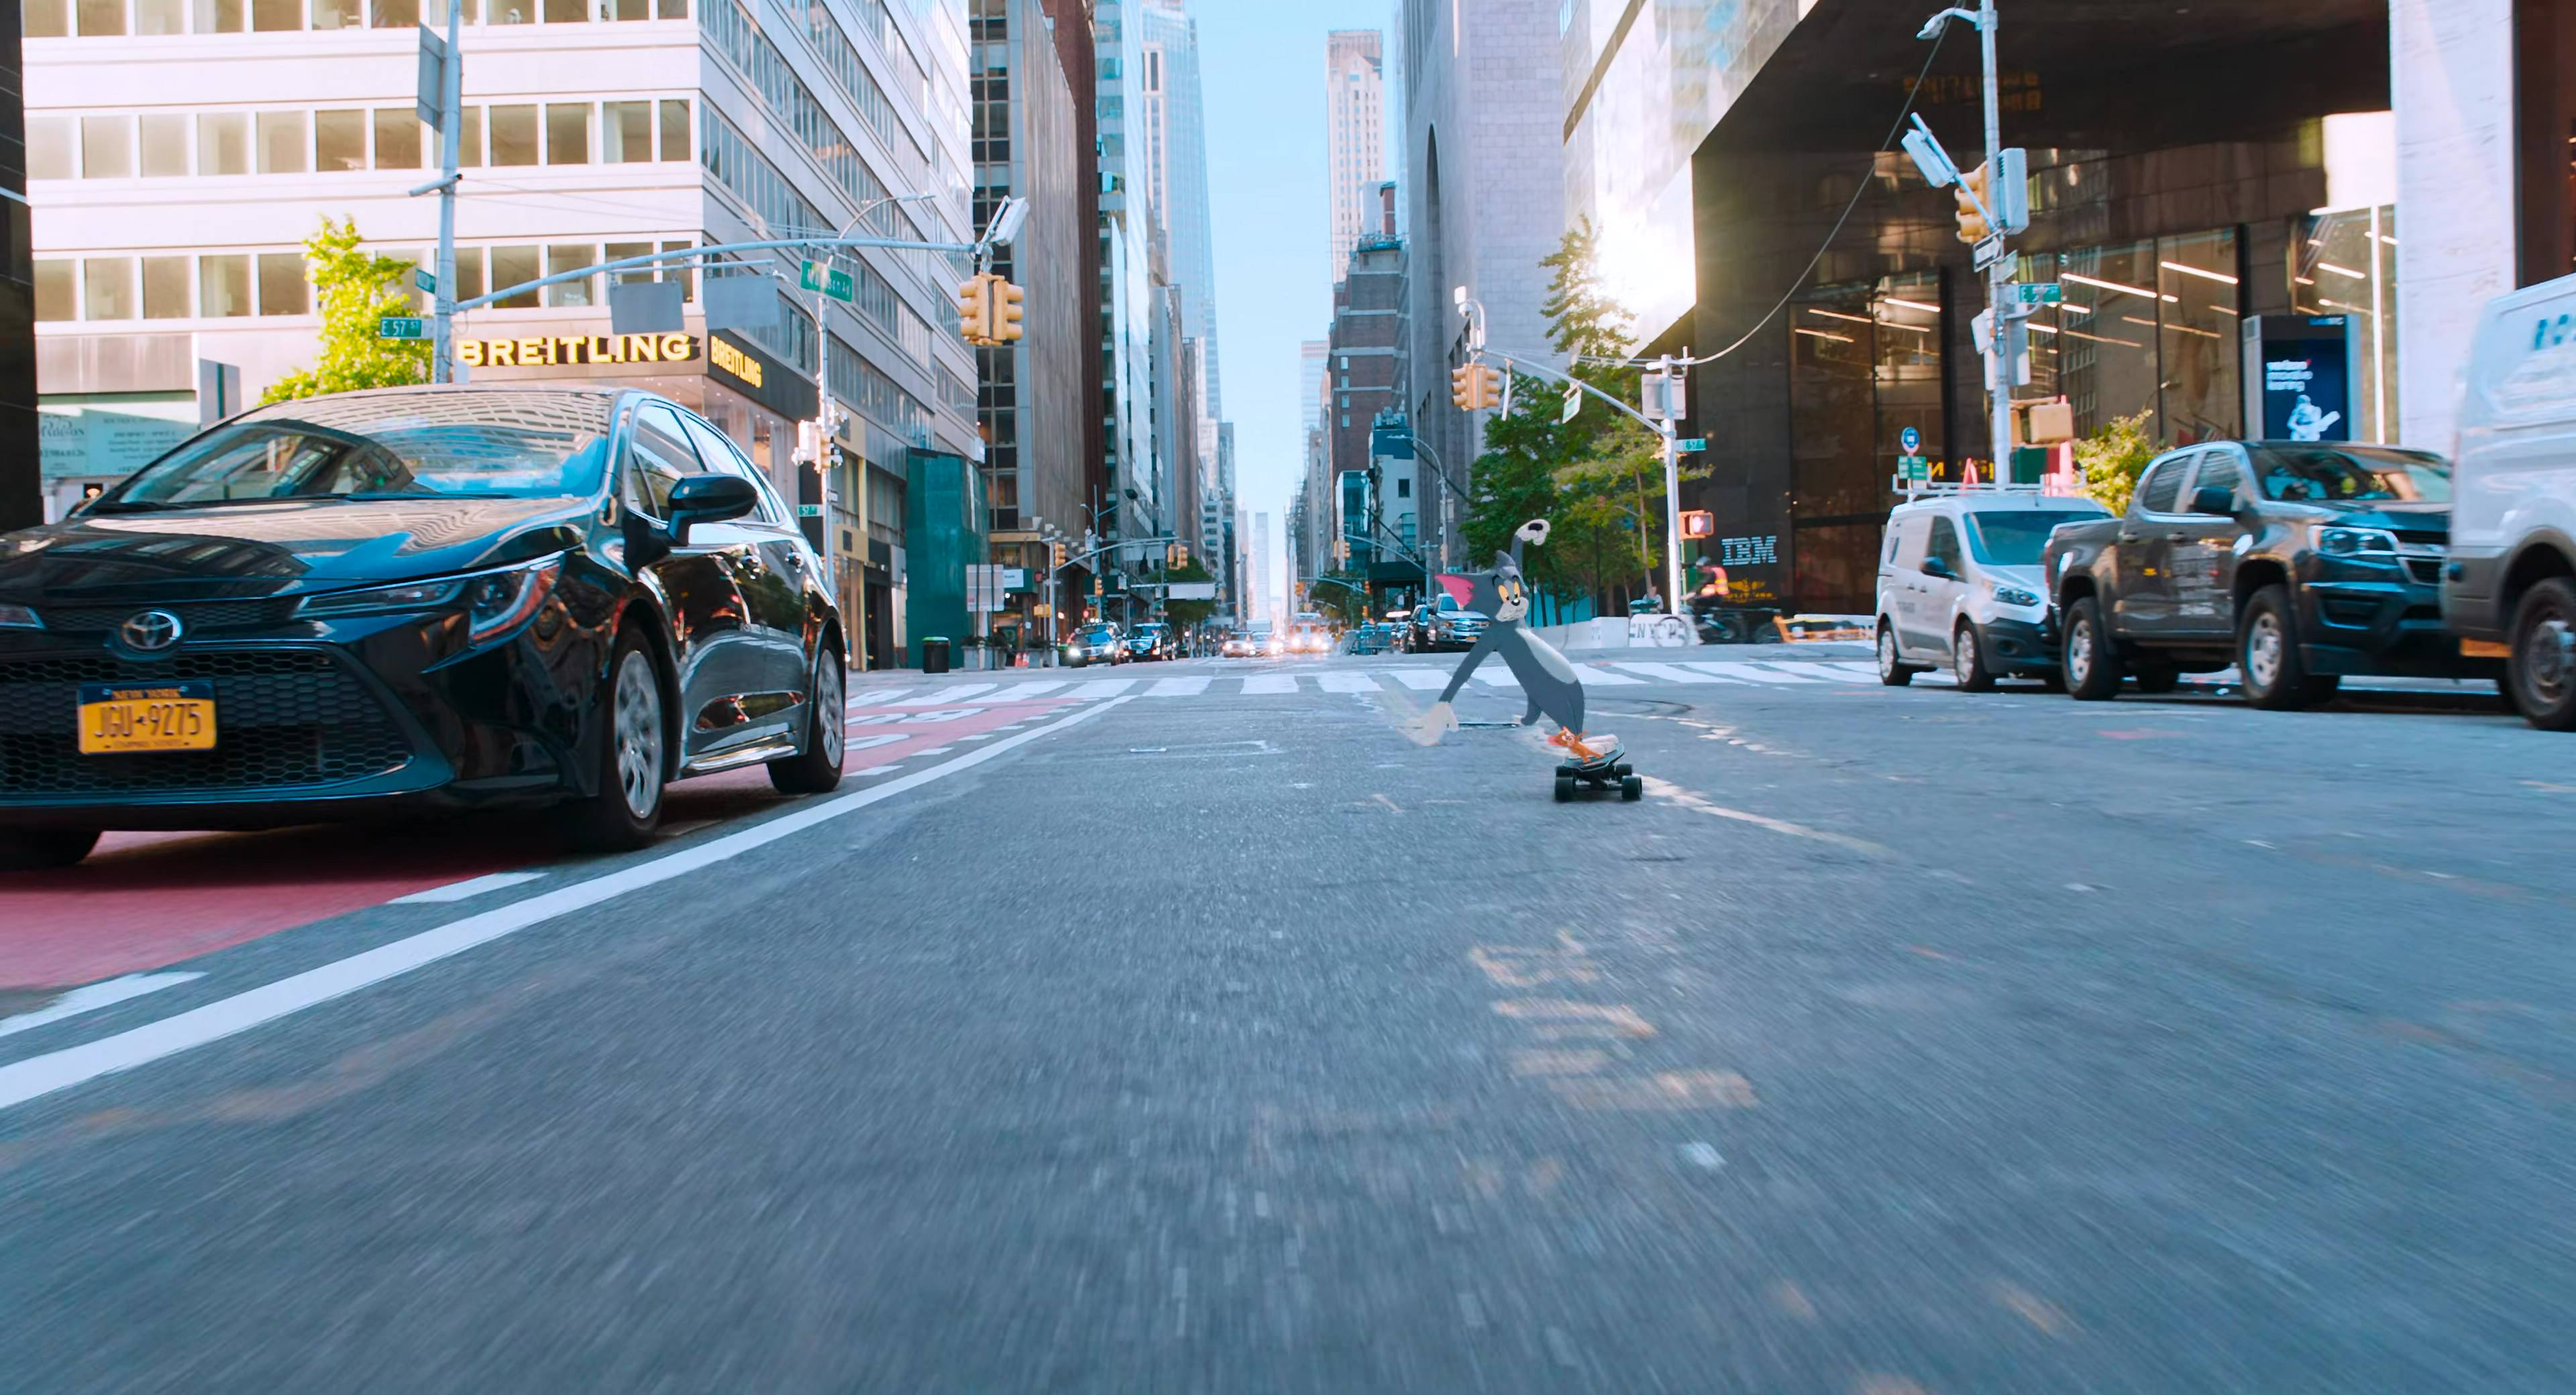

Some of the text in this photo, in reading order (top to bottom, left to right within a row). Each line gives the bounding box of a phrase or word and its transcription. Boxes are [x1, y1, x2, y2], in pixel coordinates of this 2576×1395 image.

[381, 321, 388, 336] E
[392, 321, 407, 336] 57
[457, 334, 692, 367] BREITLING
[710, 335, 762, 388] BREITLING
[1721, 536, 1777, 565] IBM
[148, 702, 201, 736] 9275
